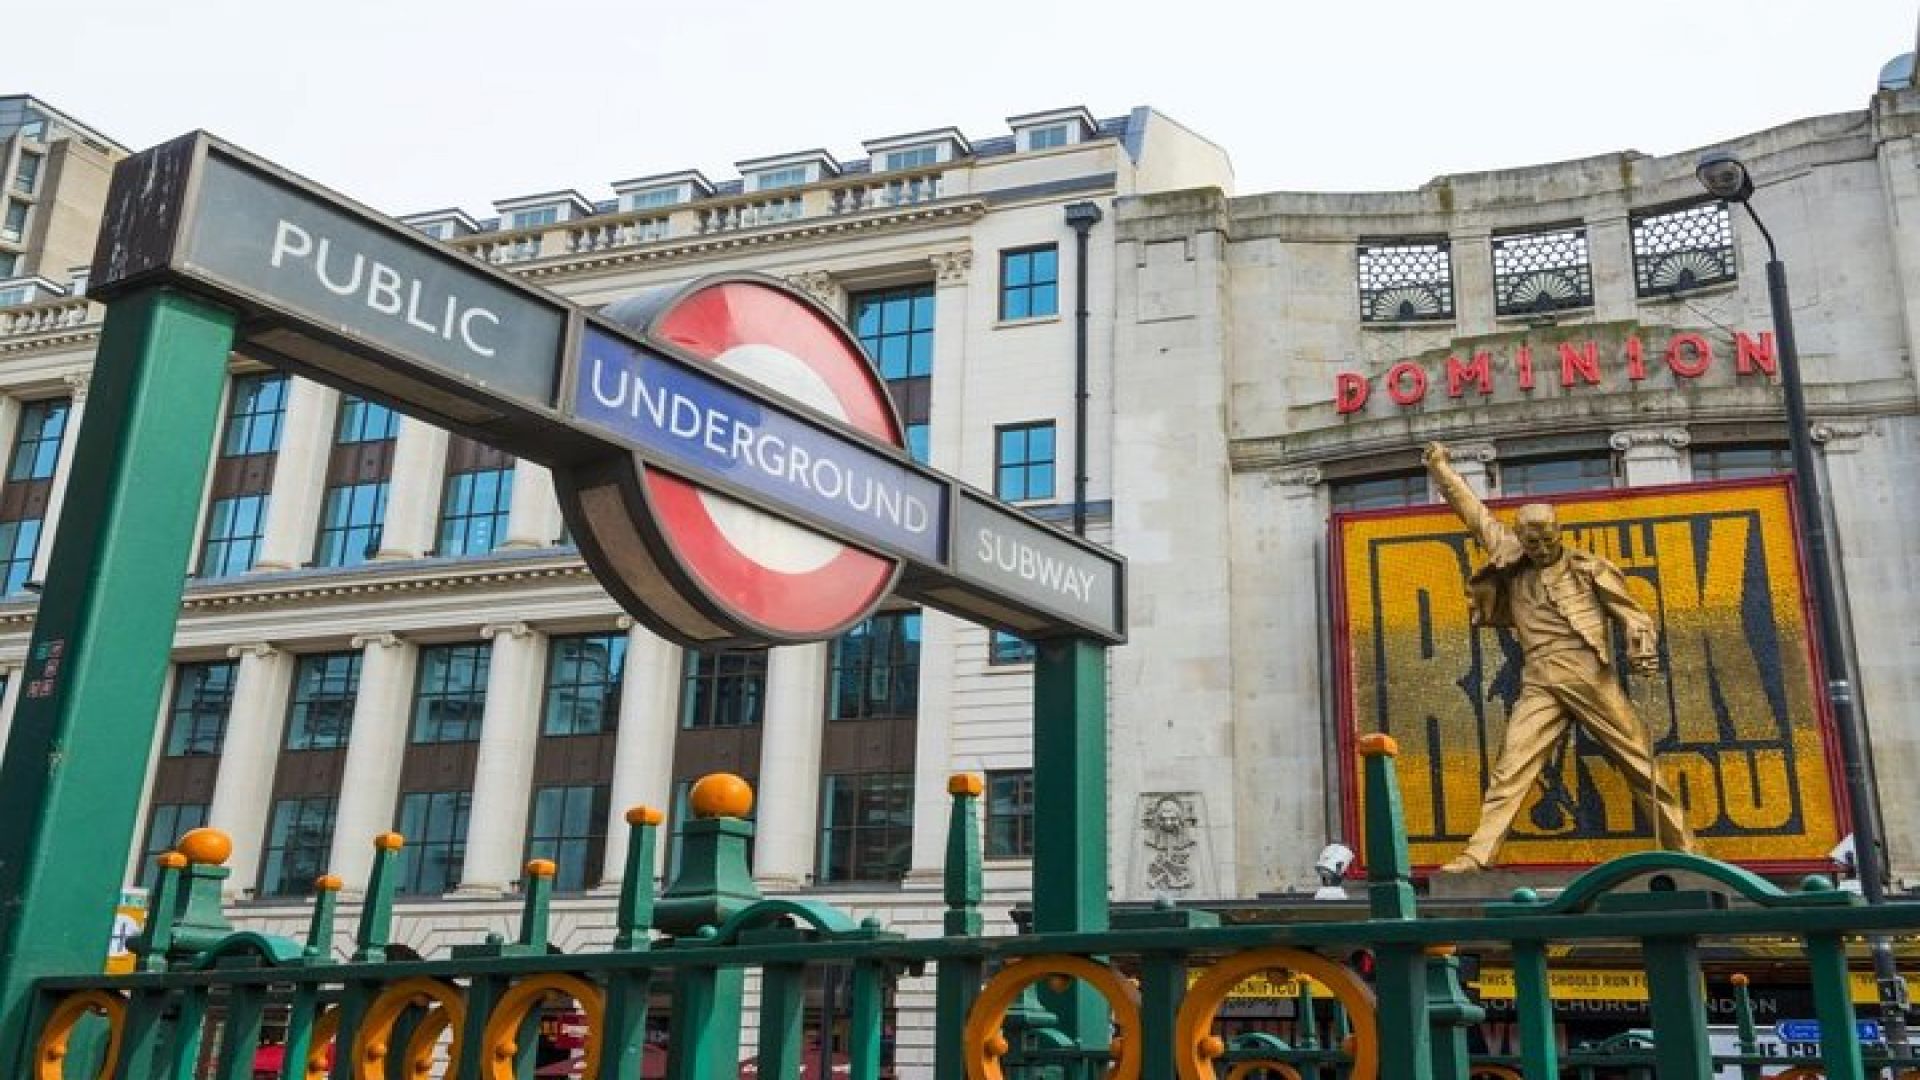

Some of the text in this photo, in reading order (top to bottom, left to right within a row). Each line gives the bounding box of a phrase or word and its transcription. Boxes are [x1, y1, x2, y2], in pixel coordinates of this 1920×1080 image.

[270, 219, 501, 358] PUBLIC
[1334, 331, 1779, 414] DOMINION
[590, 358, 930, 534] UNDERGROUND
[977, 527, 1097, 605] SUBWAY
